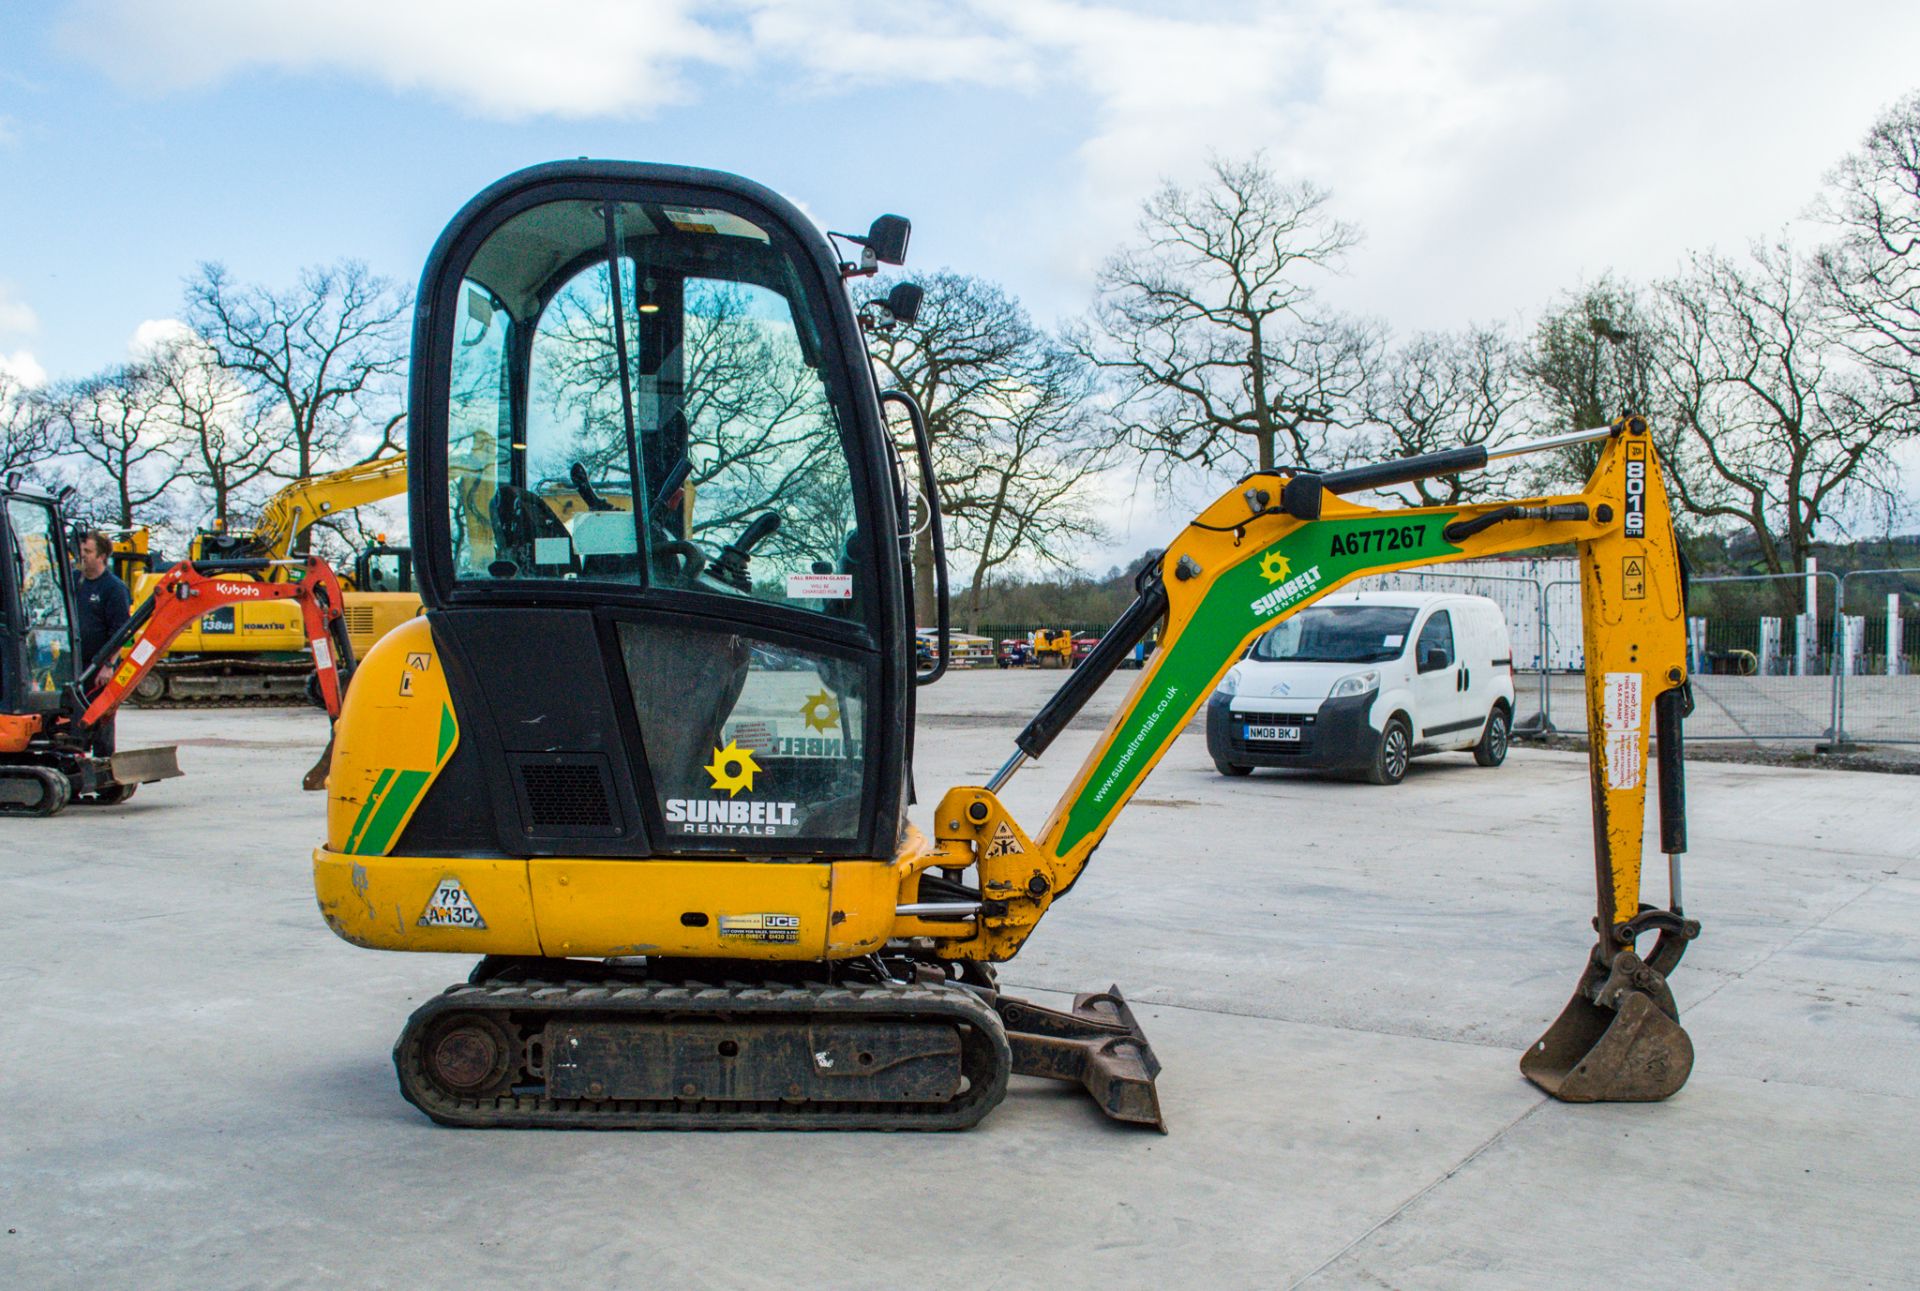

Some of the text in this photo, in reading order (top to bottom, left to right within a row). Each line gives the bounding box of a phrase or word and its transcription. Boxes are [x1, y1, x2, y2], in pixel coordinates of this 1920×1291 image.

[1626, 462, 1645, 528] 8016
[1330, 525, 1426, 557] A677267
[216, 583, 259, 596] Kubota
[1250, 565, 1321, 616] SUNBELT
[1266, 584, 1317, 616] RENTALS
[1094, 685, 1178, 803] www.sunbeltrentals.co.uk
[1250, 727, 1298, 739] NM08 BKJ
[666, 799, 796, 825] SUNBELT
[683, 824, 776, 835] RENTALS
[440, 889, 460, 905] 79
[766, 917, 800, 926] JCB
